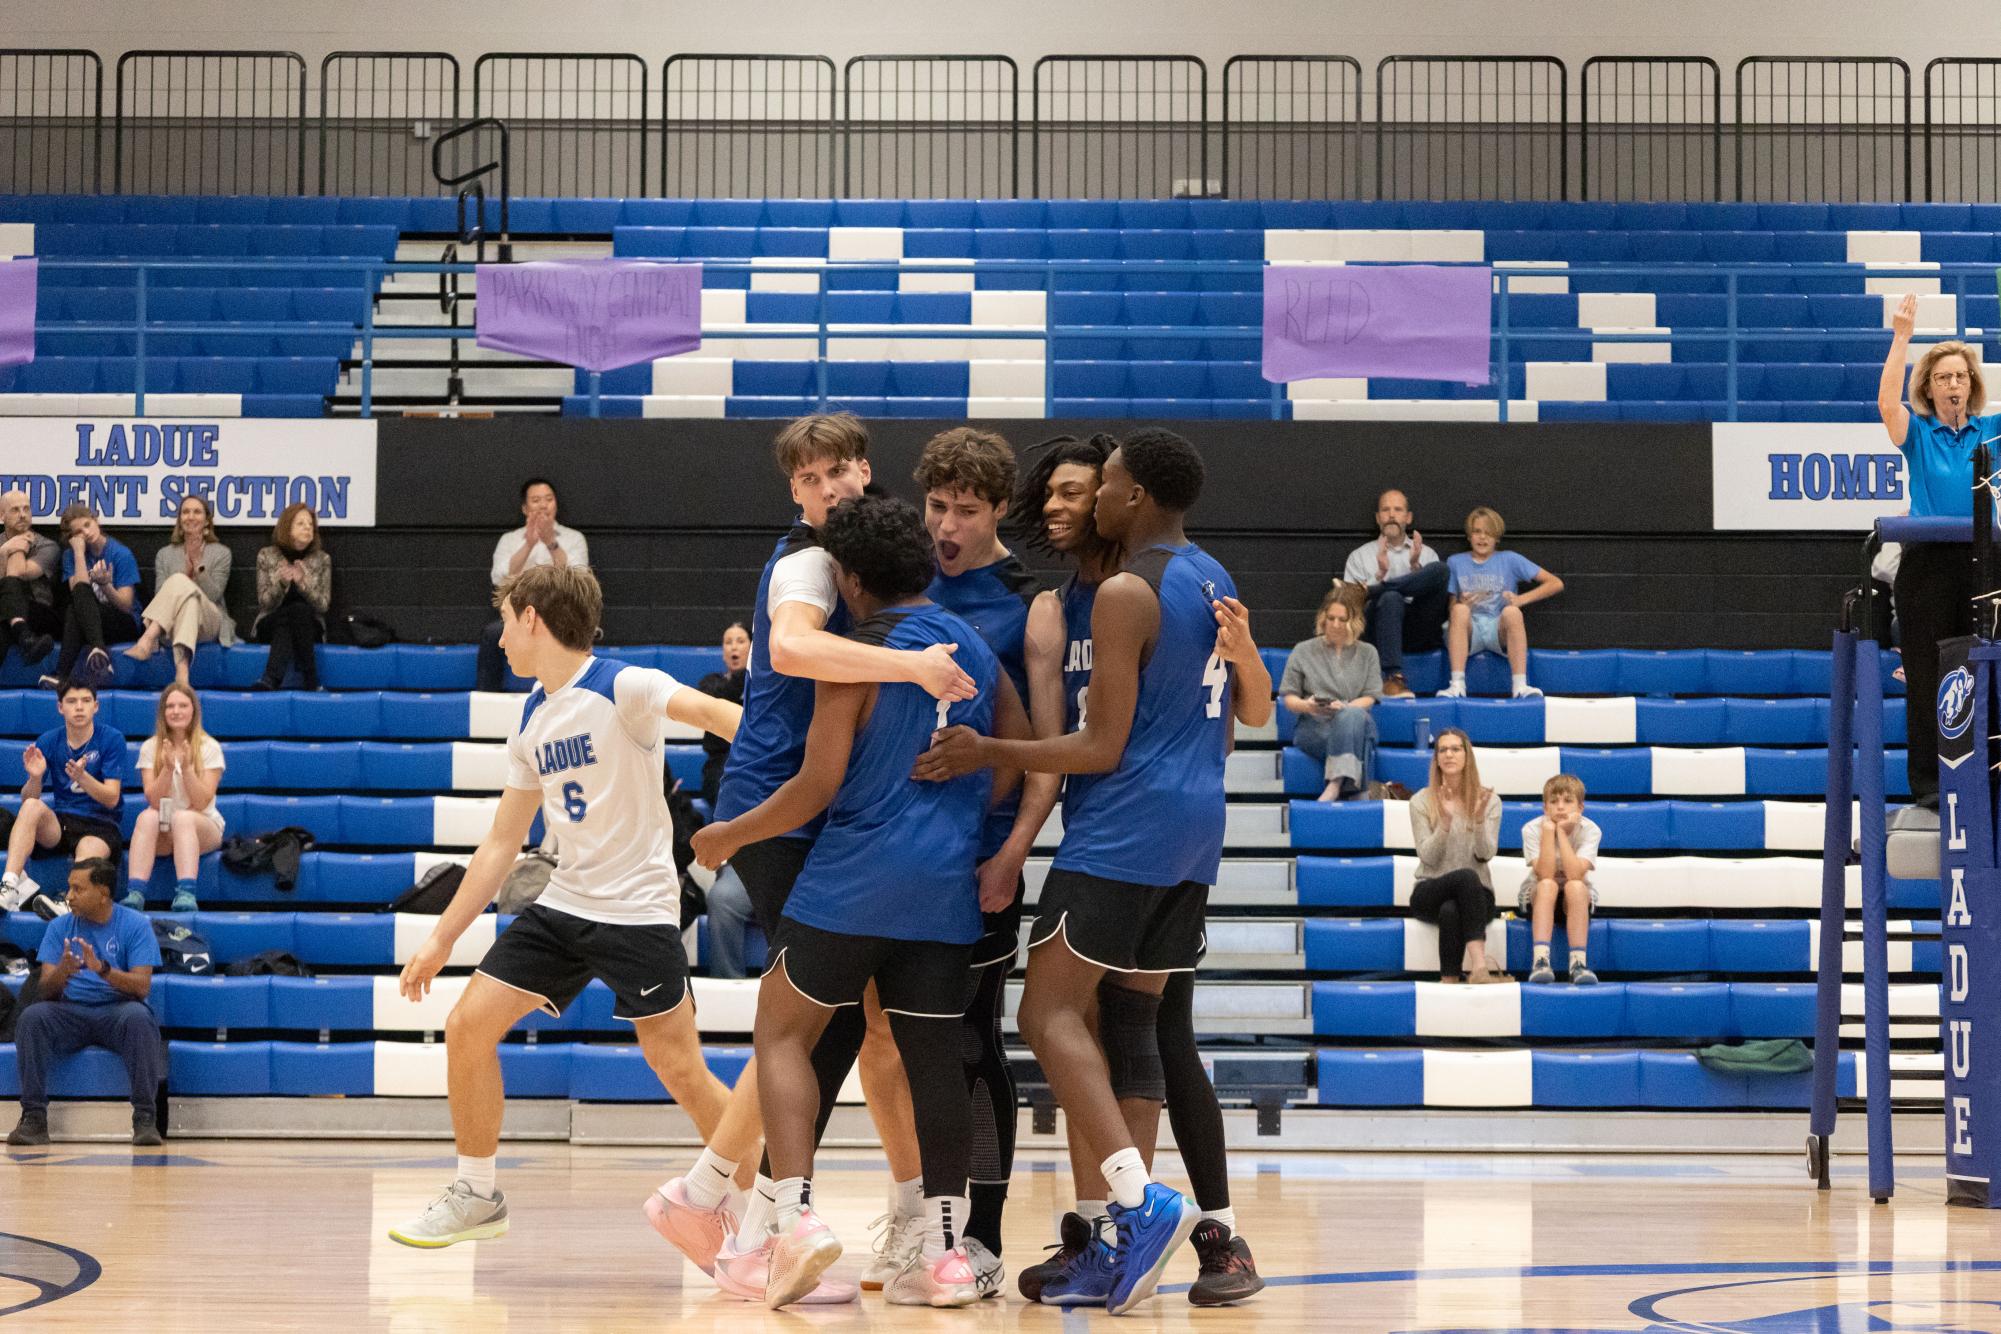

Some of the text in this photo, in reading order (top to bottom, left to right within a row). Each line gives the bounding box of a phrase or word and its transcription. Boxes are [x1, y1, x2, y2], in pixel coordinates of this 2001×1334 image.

[75, 423, 219, 468] LADUE
[1768, 453, 1903, 501] HOME
[1202, 649, 1228, 719] 4
[535, 732, 598, 777] LADUE
[562, 780, 587, 823] 6
[1947, 793, 1973, 1155] LADUE
